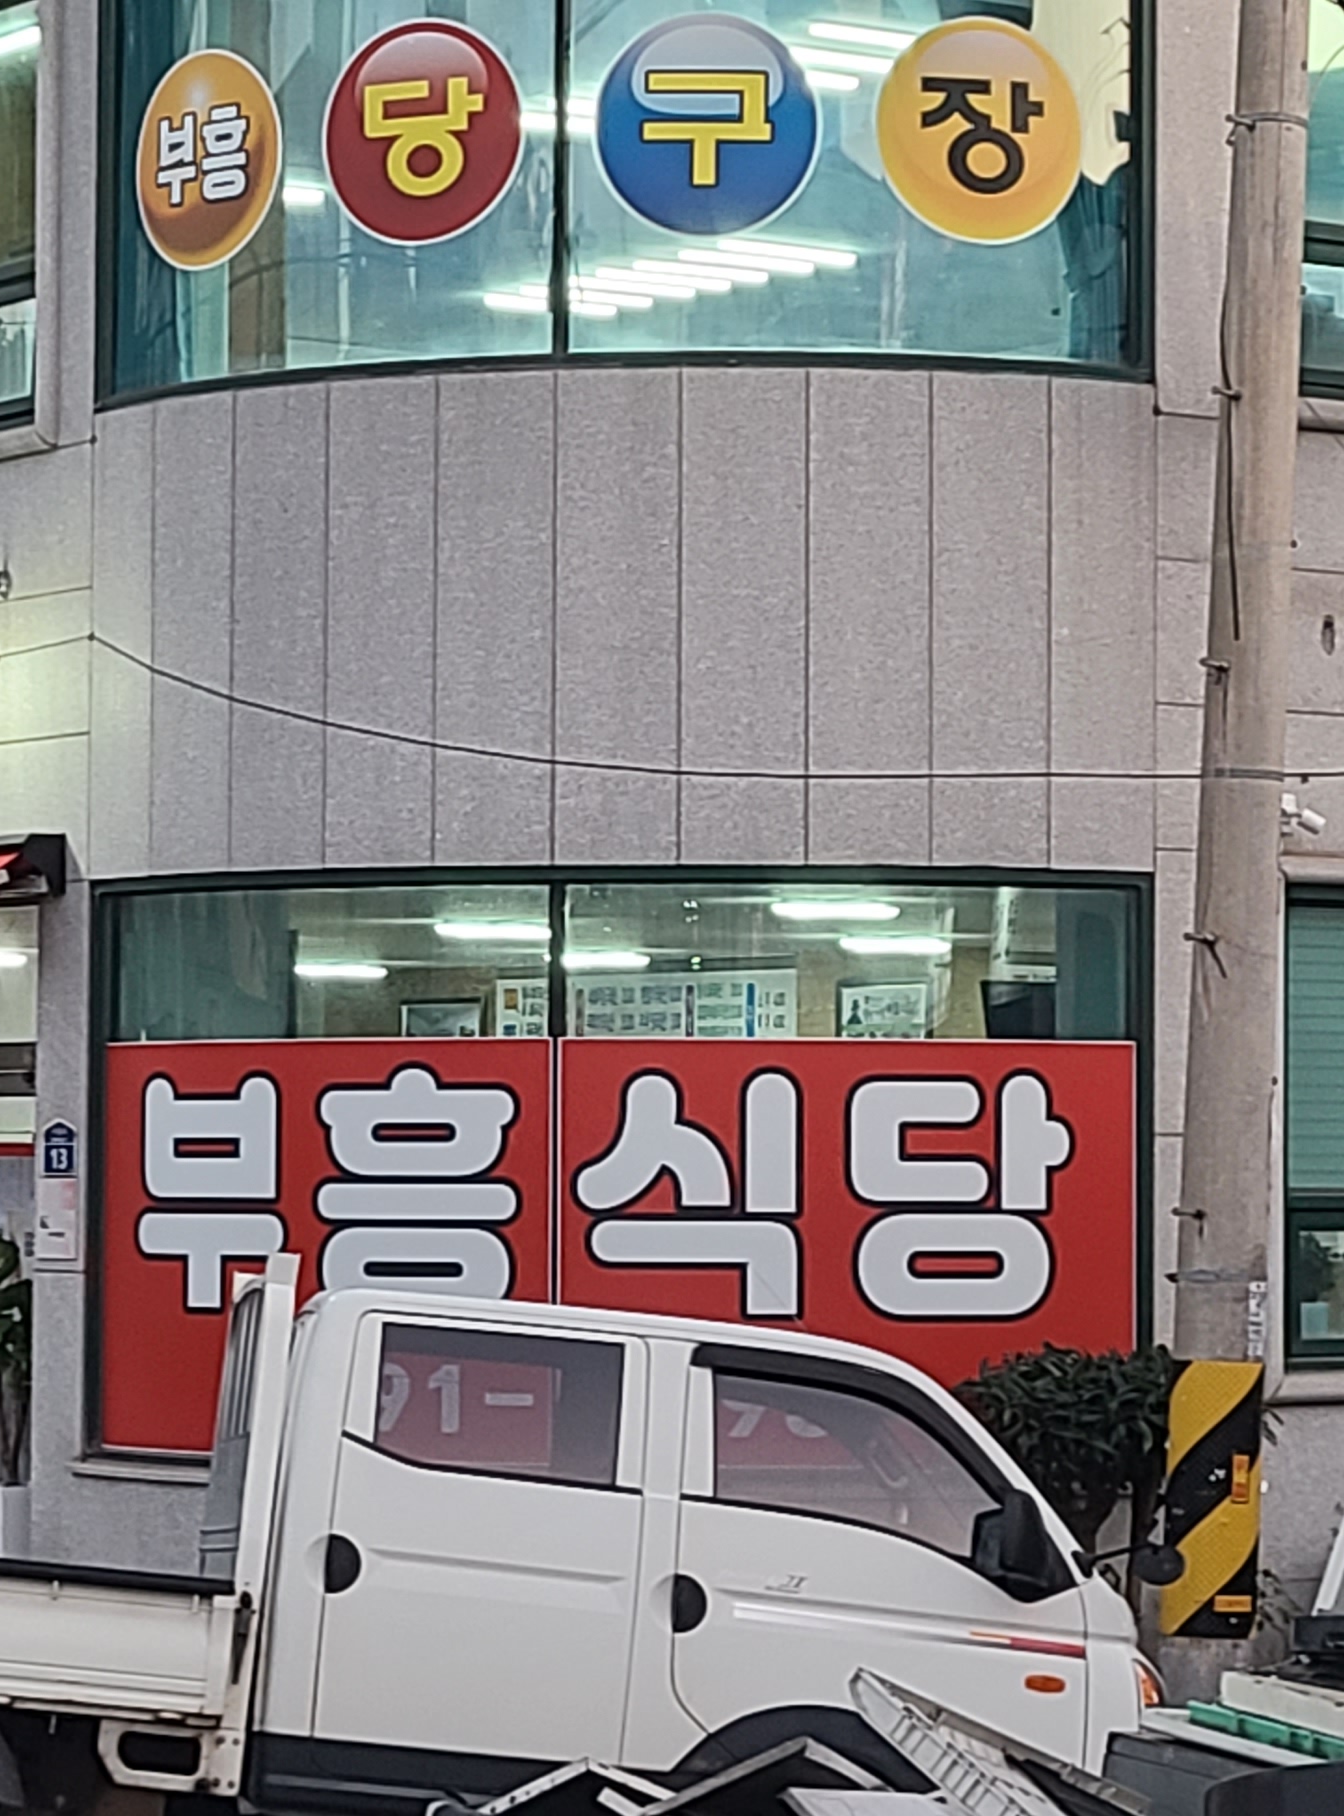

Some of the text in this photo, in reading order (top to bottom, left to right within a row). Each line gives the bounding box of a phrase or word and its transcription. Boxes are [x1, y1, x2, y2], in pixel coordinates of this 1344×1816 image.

[155, 69, 1044, 206] 부흥 당 구 장
[49, 1147, 69, 1171] 13
[135, 1064, 1074, 1320] 부흥식당
